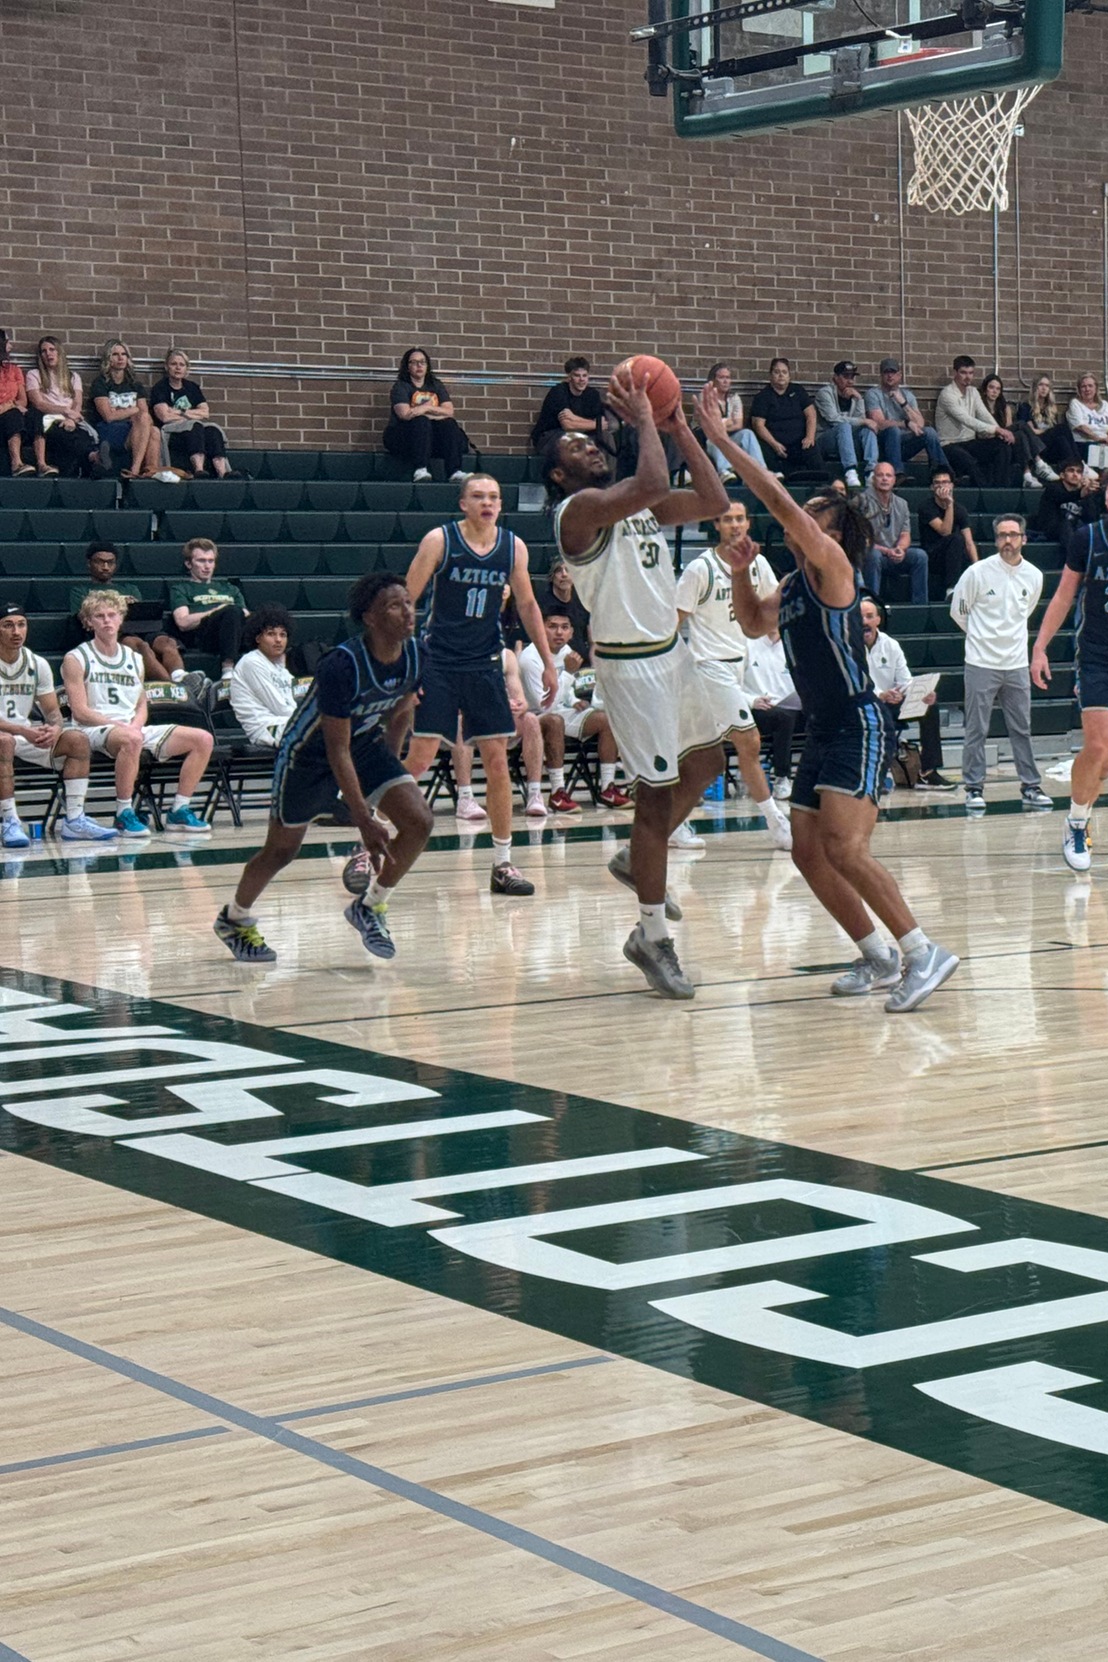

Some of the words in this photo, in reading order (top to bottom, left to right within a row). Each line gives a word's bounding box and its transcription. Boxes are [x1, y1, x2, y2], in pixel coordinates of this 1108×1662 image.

[449, 567, 507, 586] AZTECS
[465, 587, 487, 618] 11
[107, 687, 120, 705] 5
[6, 699, 16, 718] 2
